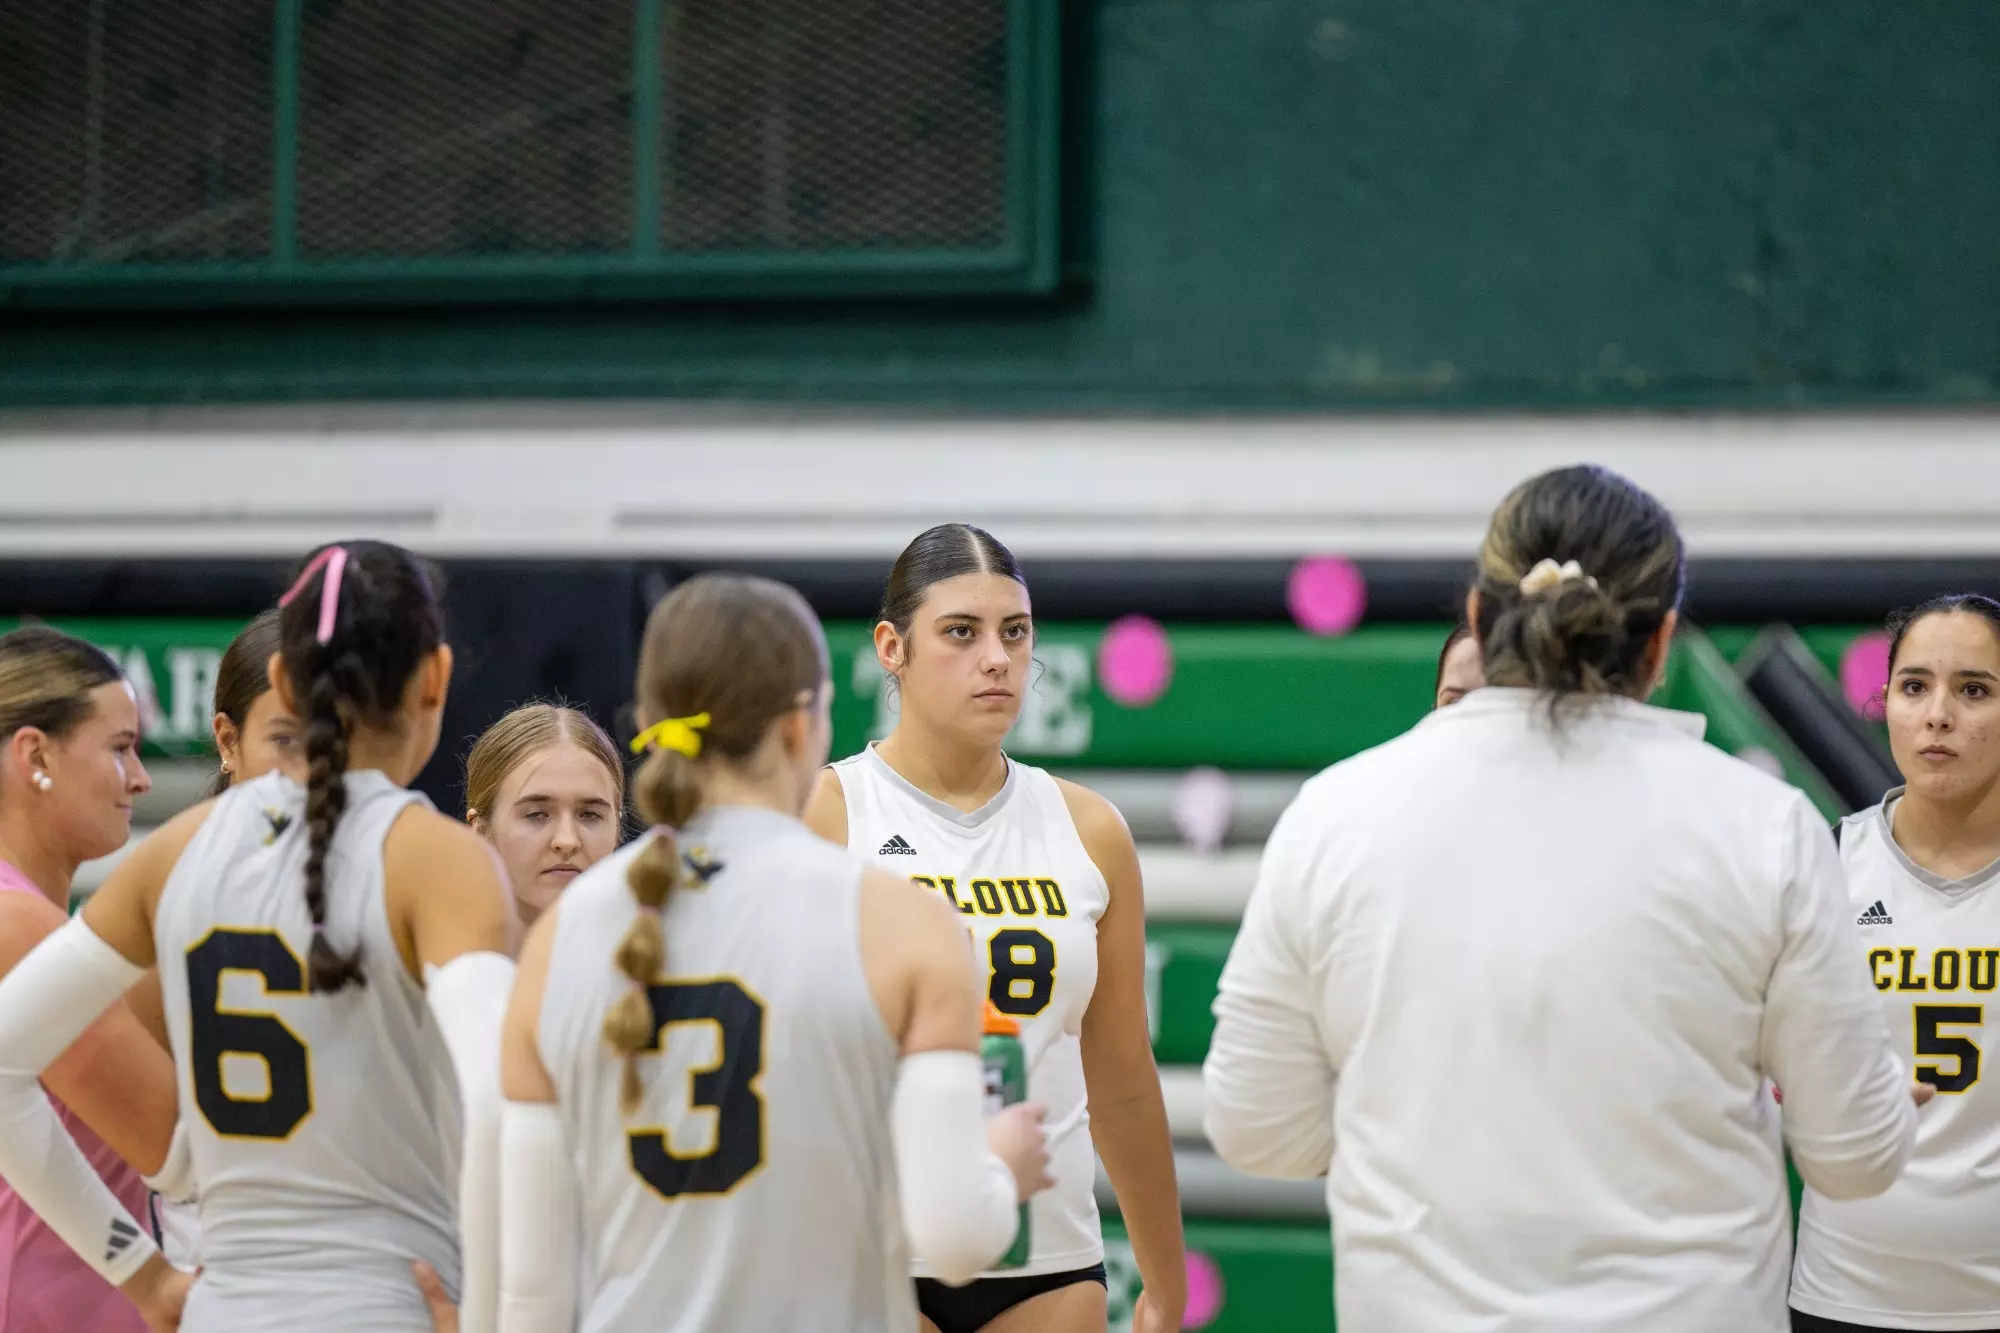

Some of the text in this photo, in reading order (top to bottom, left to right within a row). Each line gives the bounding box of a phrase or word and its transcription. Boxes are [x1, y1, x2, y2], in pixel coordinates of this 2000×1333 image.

[879, 845, 917, 855] adidas
[1857, 914, 1893, 925] adidas
[185, 924, 316, 1142] 6
[1913, 1003, 1984, 1095] 5
[626, 974, 769, 1202] 3
